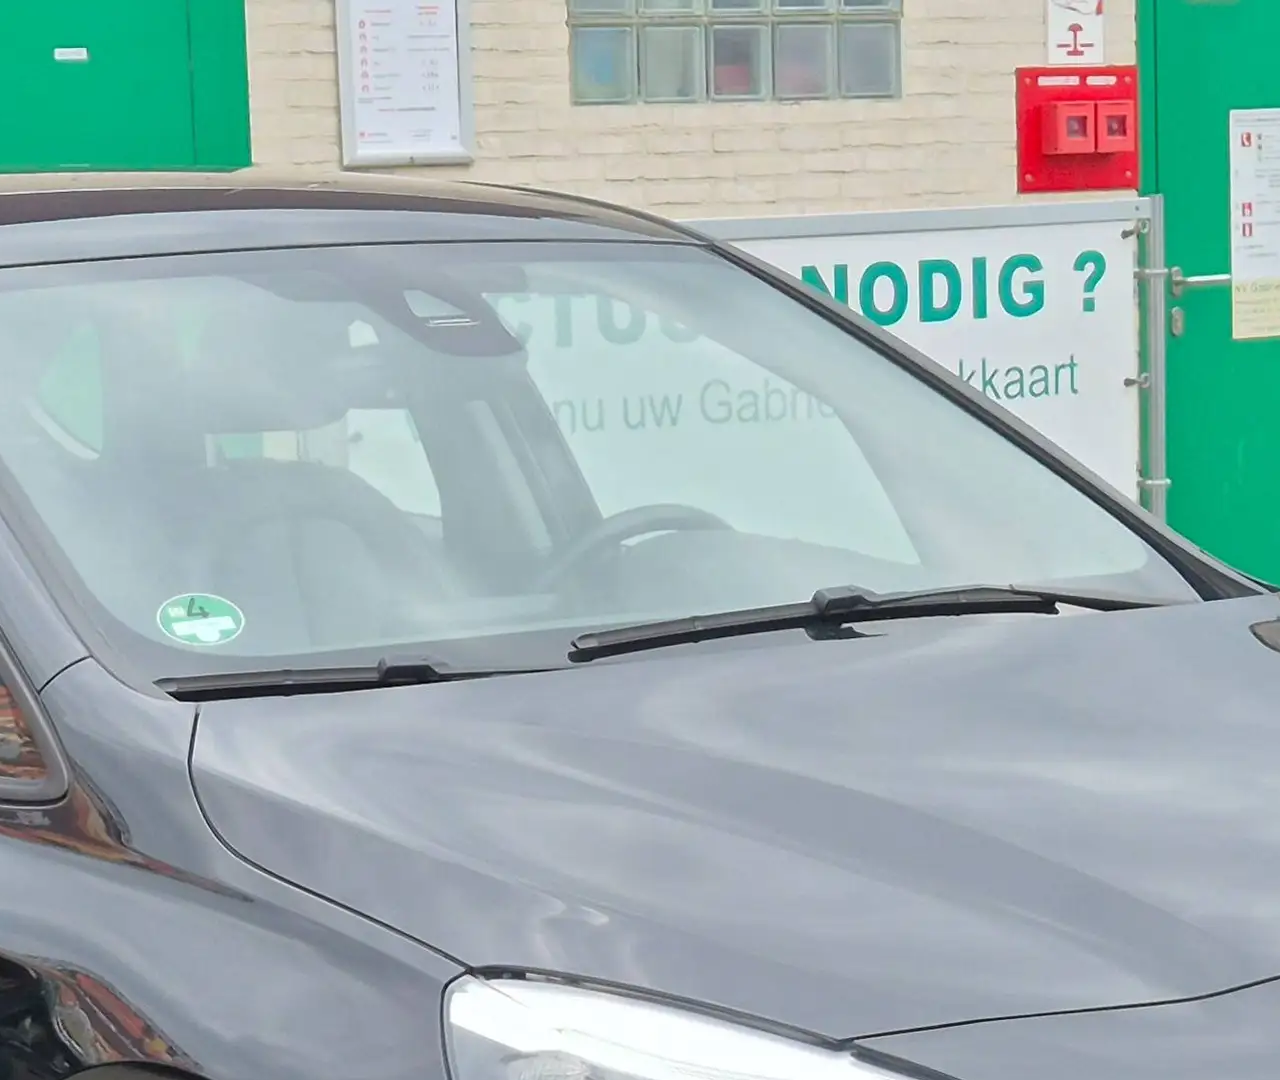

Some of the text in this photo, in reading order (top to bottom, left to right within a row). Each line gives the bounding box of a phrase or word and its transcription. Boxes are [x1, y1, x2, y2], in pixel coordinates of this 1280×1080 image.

[801, 250, 1107, 326] NODIG ?
[622, 392, 683, 430] uw
